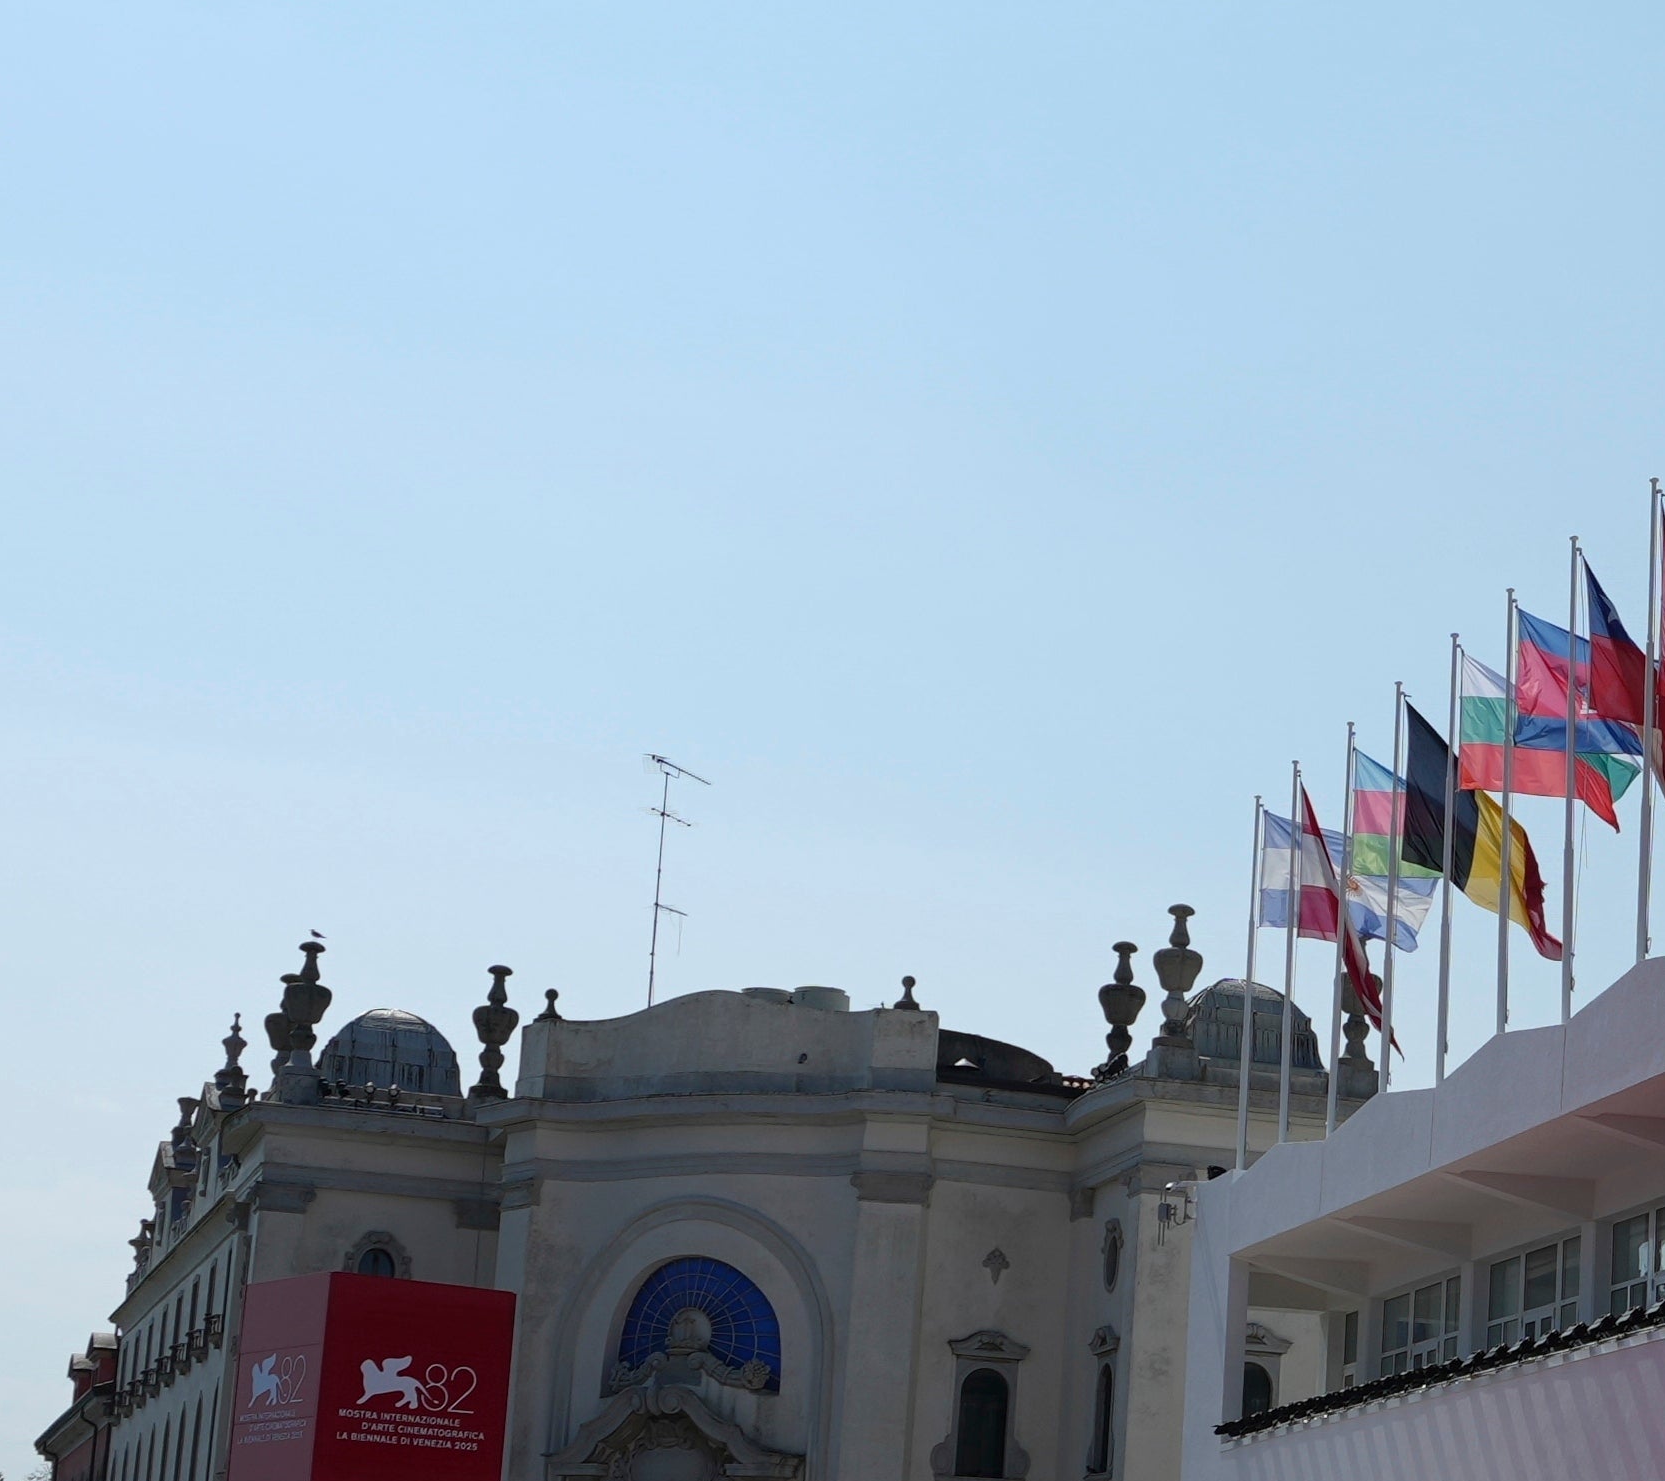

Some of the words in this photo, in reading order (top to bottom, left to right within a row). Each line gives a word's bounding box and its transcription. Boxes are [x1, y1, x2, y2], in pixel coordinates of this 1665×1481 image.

[420, 1363, 478, 1414] 82
[338, 1408, 378, 1420] MOSTRA
[381, 1412, 461, 1427] INTERNAZIONALE
[336, 1431, 348, 1441] LA
[350, 1433, 398, 1444] BIENNALE
[400, 1437, 410, 1445] DI
[412, 1438, 452, 1449] VENEZIA
[454, 1441, 479, 1451] 2025
[397, 1425, 485, 1440] CINEMATOGRAFICA
